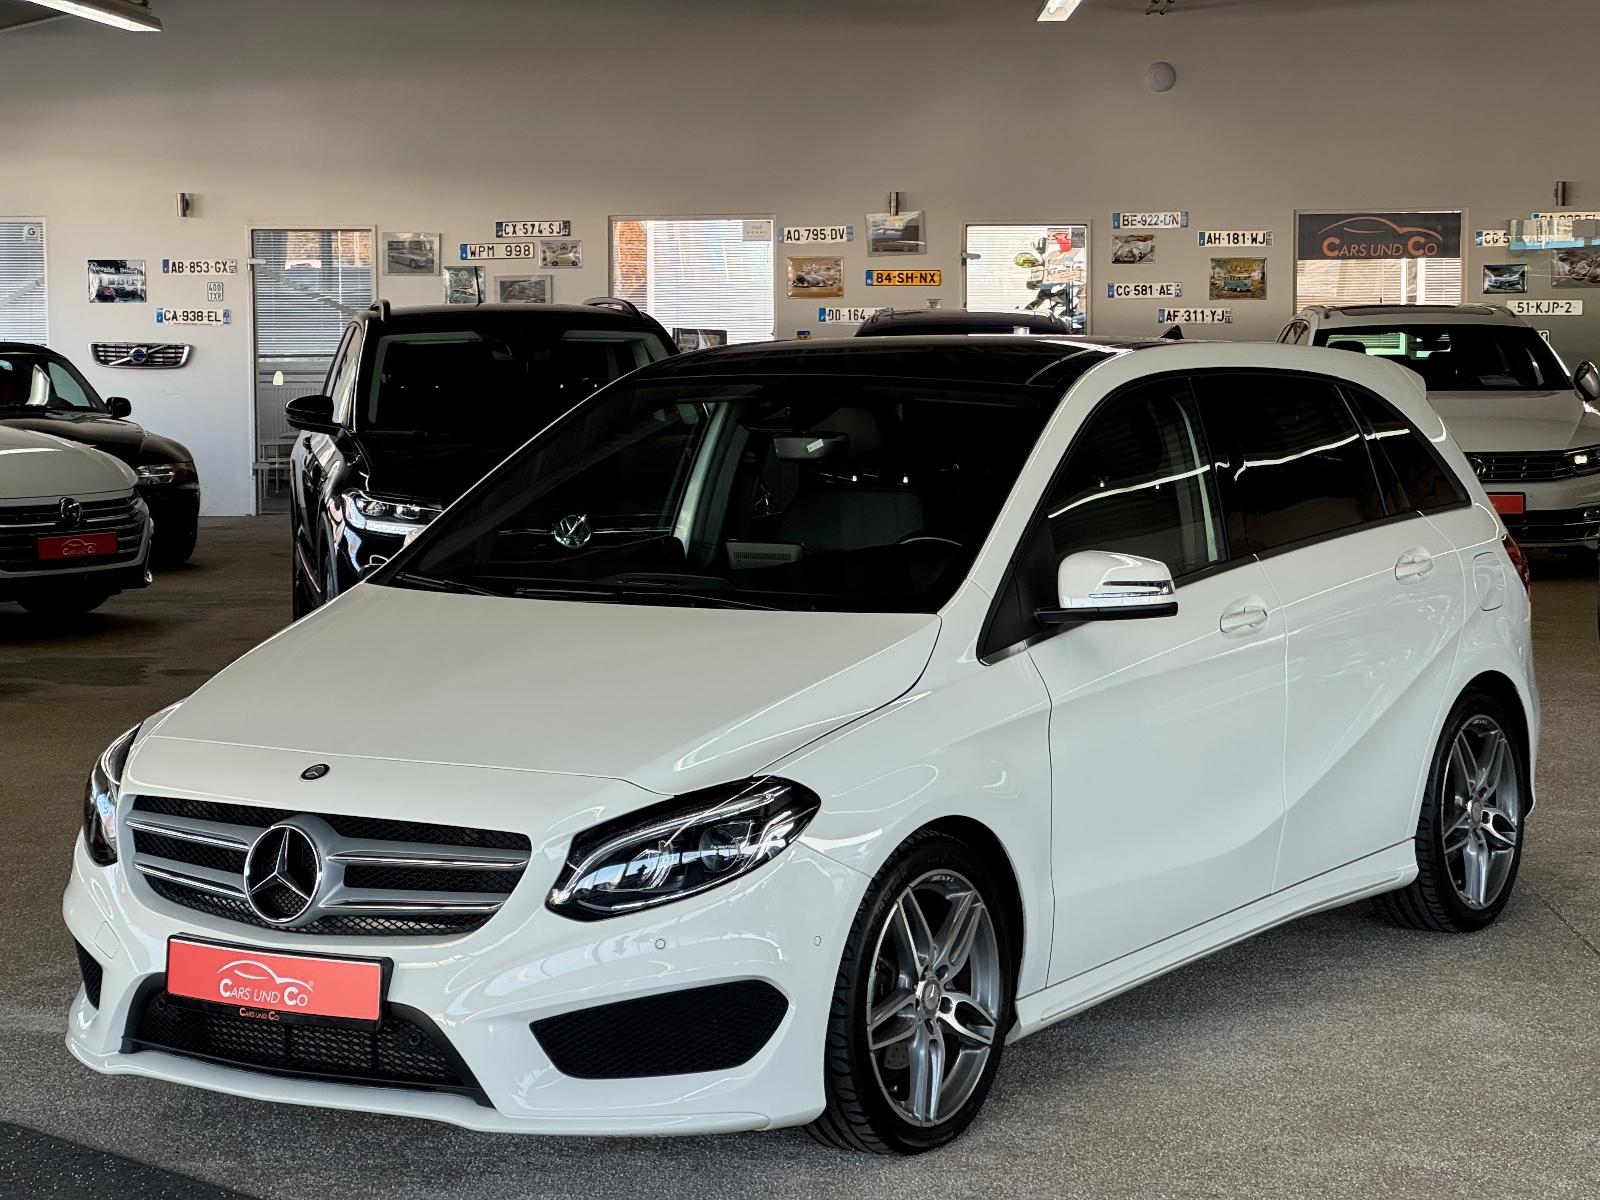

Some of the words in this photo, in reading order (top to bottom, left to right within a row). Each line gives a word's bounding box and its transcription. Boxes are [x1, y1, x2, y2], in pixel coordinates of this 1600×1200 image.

[503, 223, 562, 235] CX-574-SJ
[785, 228, 845, 242] AQ-795-DV
[1206, 232, 1266, 245] AH-181-WJ
[469, 245, 495, 258] WPM
[505, 244, 531, 257] 998
[171, 261, 228, 273] AB-853-GX
[876, 272, 936, 284] 84-SH-NX
[1116, 284, 1173, 296] CG-581-AE
[1517, 301, 1572, 313] 51-KJP-2
[164, 310, 222, 322] CA-938-EL
